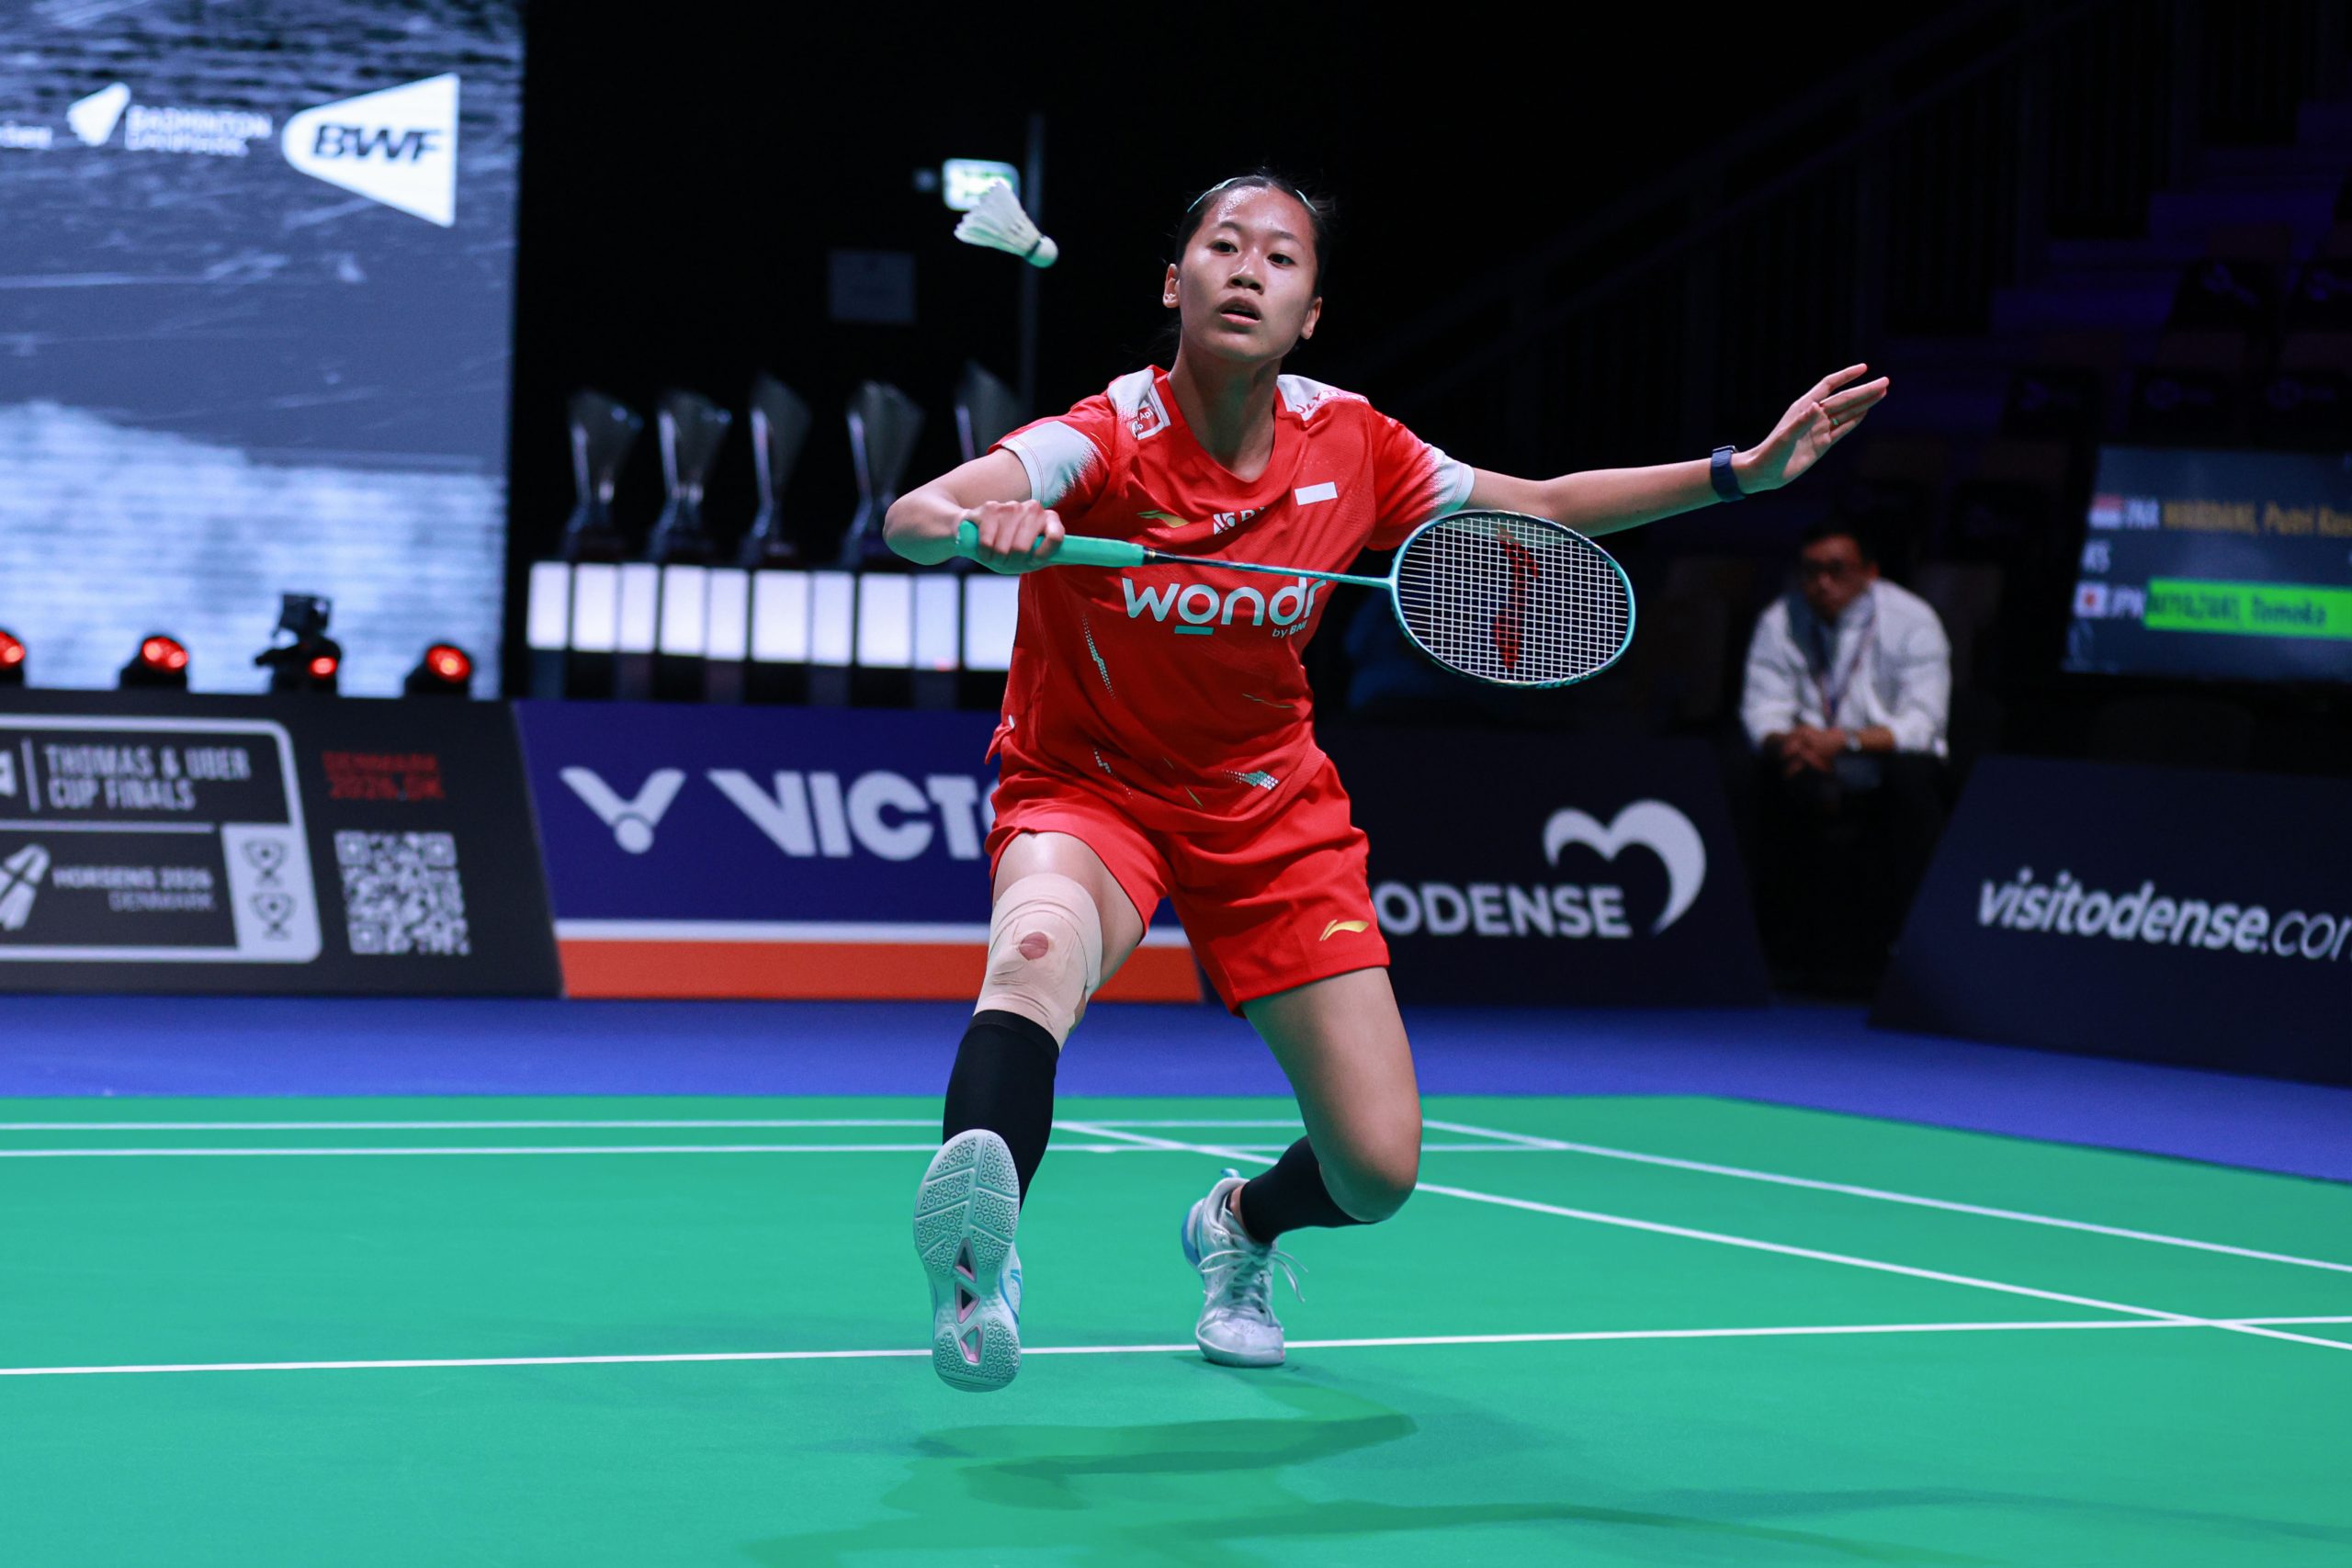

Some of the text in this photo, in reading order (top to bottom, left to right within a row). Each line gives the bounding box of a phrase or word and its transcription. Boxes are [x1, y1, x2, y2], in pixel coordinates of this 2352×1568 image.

[314, 124, 441, 160] BWF
[1123, 576, 1327, 626] wondr
[1272, 628, 1288, 638] by
[44, 744, 251, 779] THOMAS & UBER
[48, 778, 196, 810] CUP FINALS
[706, 769, 996, 860] VICT
[1374, 881, 1634, 937] ODENSE
